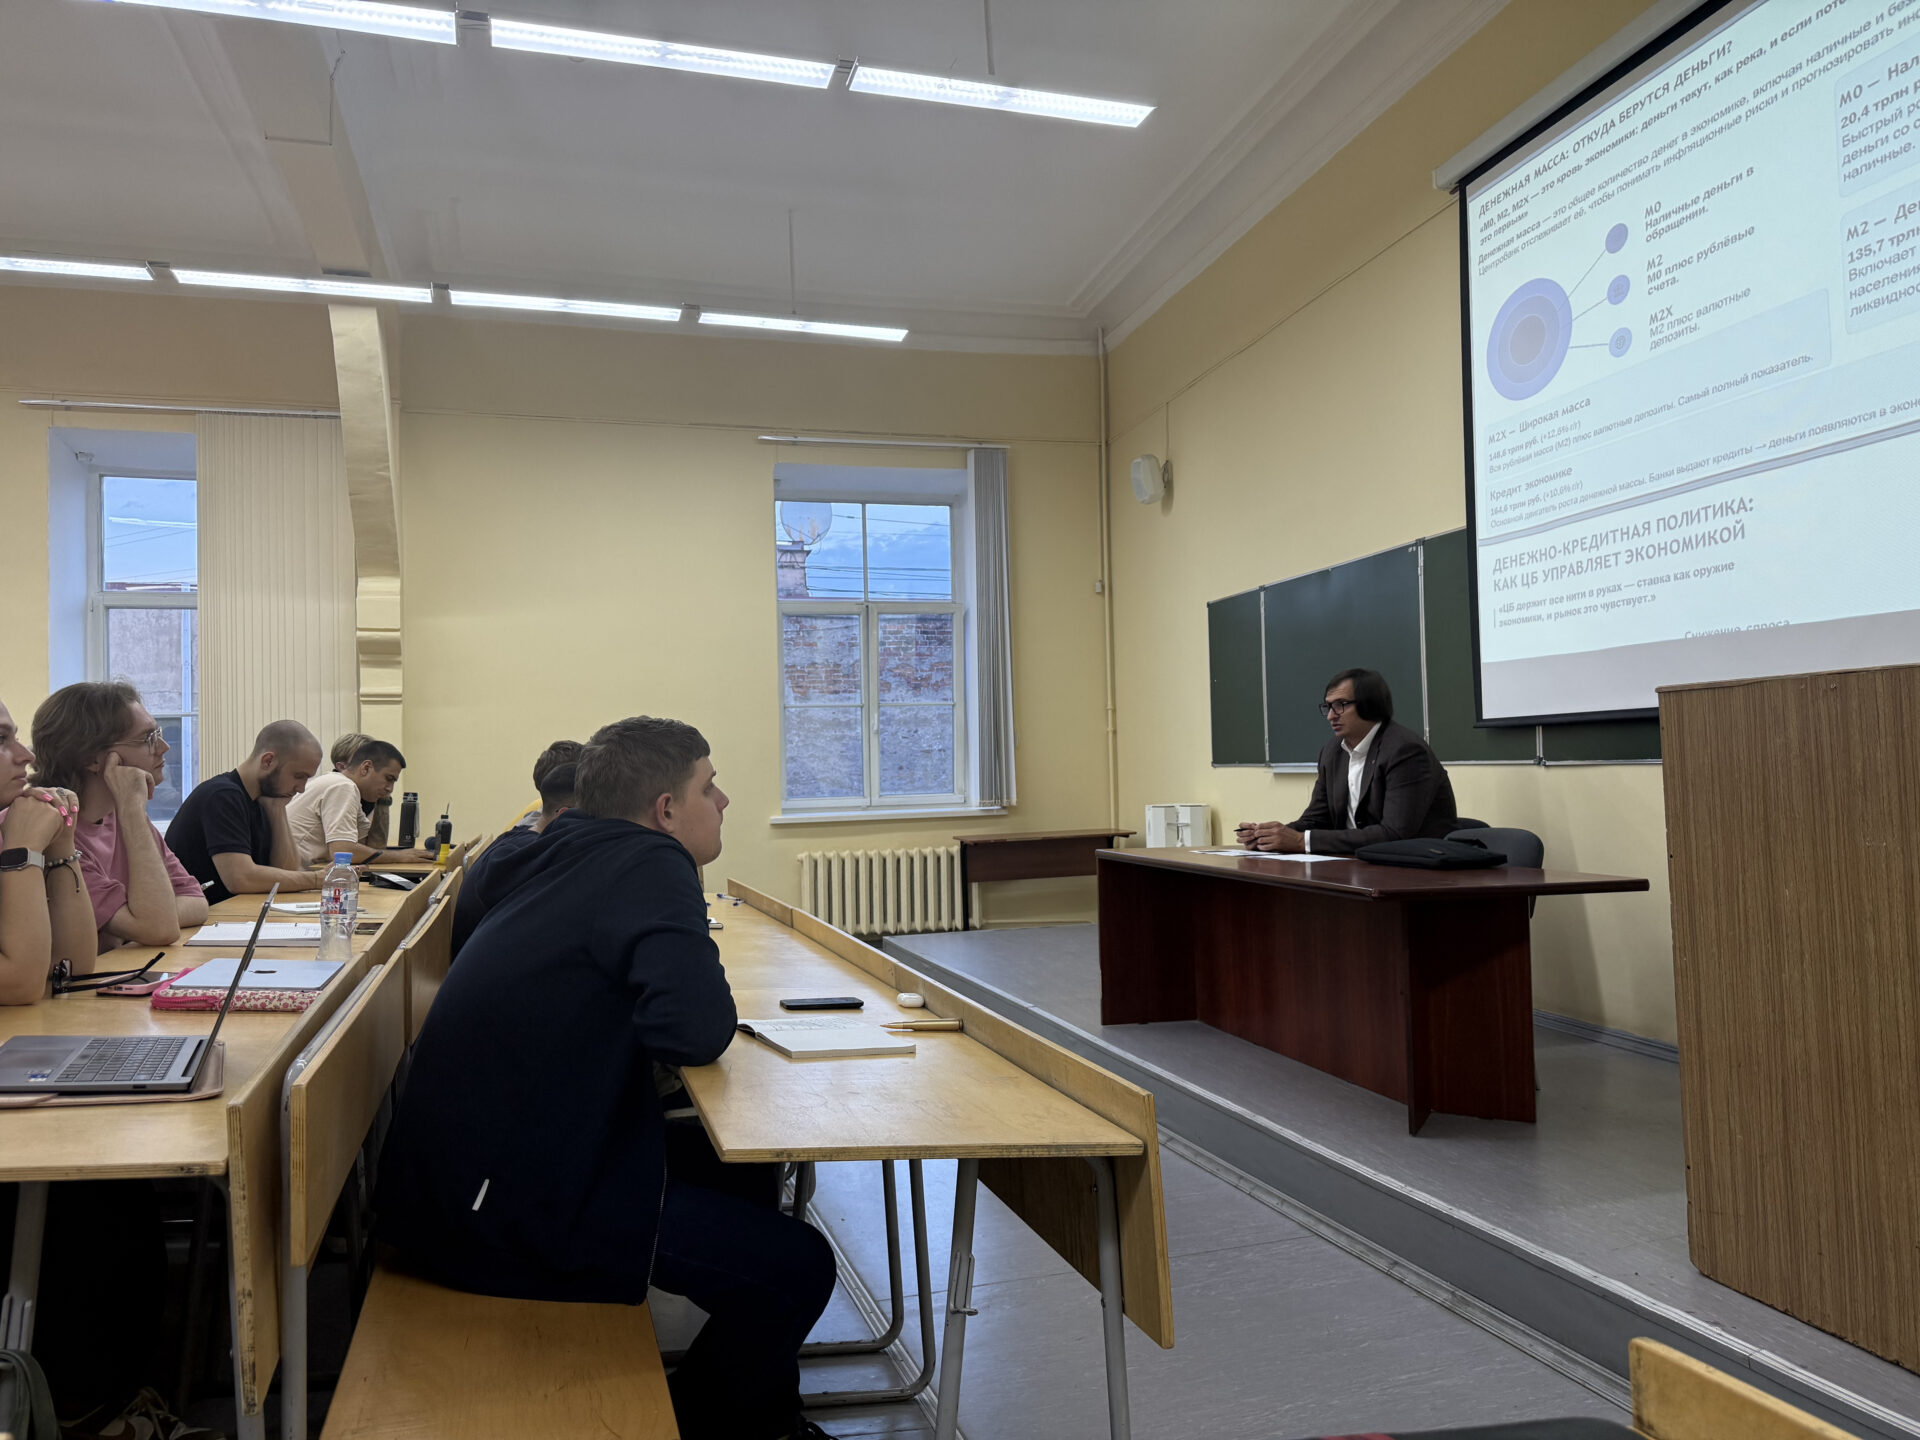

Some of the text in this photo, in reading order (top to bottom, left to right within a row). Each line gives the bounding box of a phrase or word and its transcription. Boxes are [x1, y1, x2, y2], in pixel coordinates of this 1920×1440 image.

[1540, 181, 1555, 195] это
[1556, 164, 1583, 185] кровь
[1585, 126, 1639, 167] экономики:
[1641, 102, 1678, 133] деньги
[1680, 81, 1712, 105] текут,
[1714, 66, 1734, 84] как
[1735, 47, 1767, 73] река,
[1770, 39, 1778, 49] и
[1780, 15, 1812, 42] если
[1840, 104, 1871, 129] 20,4
[1872, 85, 1909, 112] трлн
[1478, 40, 1733, 219] ДЕНЕЖНАЯ МАССА: ОТКУДА БЕРУТСЯ ДЕНЬГИ?
[1478, 236, 1515, 266] Денежная
[1515, 221, 1541, 241] масса
[1553, 205, 1567, 219] это
[1568, 187, 1596, 210] общее
[1597, 155, 1649, 193] количество
[1650, 136, 1679, 161] денег
[1681, 131, 1688, 142] в
[1690, 96, 1749, 136] экономике,
[1752, 62, 1803, 99] включая
[1805, 20, 1872, 67] наличные
[1875, 12, 1884, 25] и
[1842, 106, 1904, 148] Быстрый
[1842, 134, 1889, 167] деньги
[1892, 124, 1911, 140] со
[1478, 246, 1520, 276] Центробанк
[1520, 214, 1572, 251] отслеживает
[1588, 189, 1615, 210] чтобы
[1616, 164, 1662, 197] понимать
[1663, 114, 1742, 167] инфляционные
[1745, 93, 1778, 121] риски
[1781, 86, 1789, 98] и
[1791, 27, 1894, 92] прогнозировать
[1843, 141, 1916, 182] наличные.
[1645, 166, 1754, 232] Наличные деньги в
[1893, 200, 1920, 225] Де
[1480, 211, 1529, 247] это первым»
[1645, 205, 1709, 243] обращении.
[1664, 255, 1694, 275] плюс
[1696, 225, 1755, 264] рублёвые
[1847, 238, 1885, 264] 135,7
[1848, 246, 1917, 282] Включает
[1647, 278, 1680, 296] счета.
[1667, 311, 1694, 331] плюс
[1696, 287, 1751, 317] валютные
[1649, 324, 1701, 352] депозиты.
[1489, 465, 1502, 474] Вся
[1502, 454, 1533, 471] рублёвая
[1533, 446, 1554, 457] масса
[1572, 432, 1592, 444] плюс
[1593, 417, 1633, 437] валютные
[1634, 402, 1676, 424] депозиты.
[1677, 387, 1710, 407] Самый
[1712, 373, 1750, 395] полный
[1751, 353, 1815, 382] показатель.
[1519, 410, 1559, 433] Широкая
[1561, 398, 1591, 417] масса
[1508, 443, 1524, 455] трлн
[1524, 436, 1539, 449] руб.
[1490, 514, 1523, 528] Основной
[1524, 504, 1557, 521] двигатель
[1558, 497, 1579, 511] роста
[1579, 485, 1617, 504] денежной
[1619, 478, 1647, 491] массы.
[1648, 469, 1675, 482] Банки
[1676, 458, 1710, 475] выдают
[1712, 445, 1753, 465] кредиты
[1768, 431, 1807, 450] деньги
[1808, 410, 1877, 437] появляются
[1879, 408, 1887, 417] в
[1490, 466, 1573, 501] Кредит экономике
[1509, 500, 1526, 511] трлн
[1527, 494, 1542, 507] руб.
[1493, 497, 1754, 575] ДЕНЕЖНО-КРЕДИТНАЯ ПОЛИТИКА:
[1493, 519, 1746, 592] КАК ЦБ УПРАВЛЯЕТ ЭКОНОМИКОЙ
[1516, 598, 1547, 613] держит
[1549, 595, 1565, 605] все
[1566, 591, 1587, 602] нити
[1588, 590, 1594, 598] в
[1596, 583, 1622, 598] руках
[1636, 574, 1672, 588] ставка
[1674, 570, 1690, 581] как
[1693, 560, 1735, 579] оружие
[1499, 594, 1656, 628] экономики, и рынок это чувствует.»
